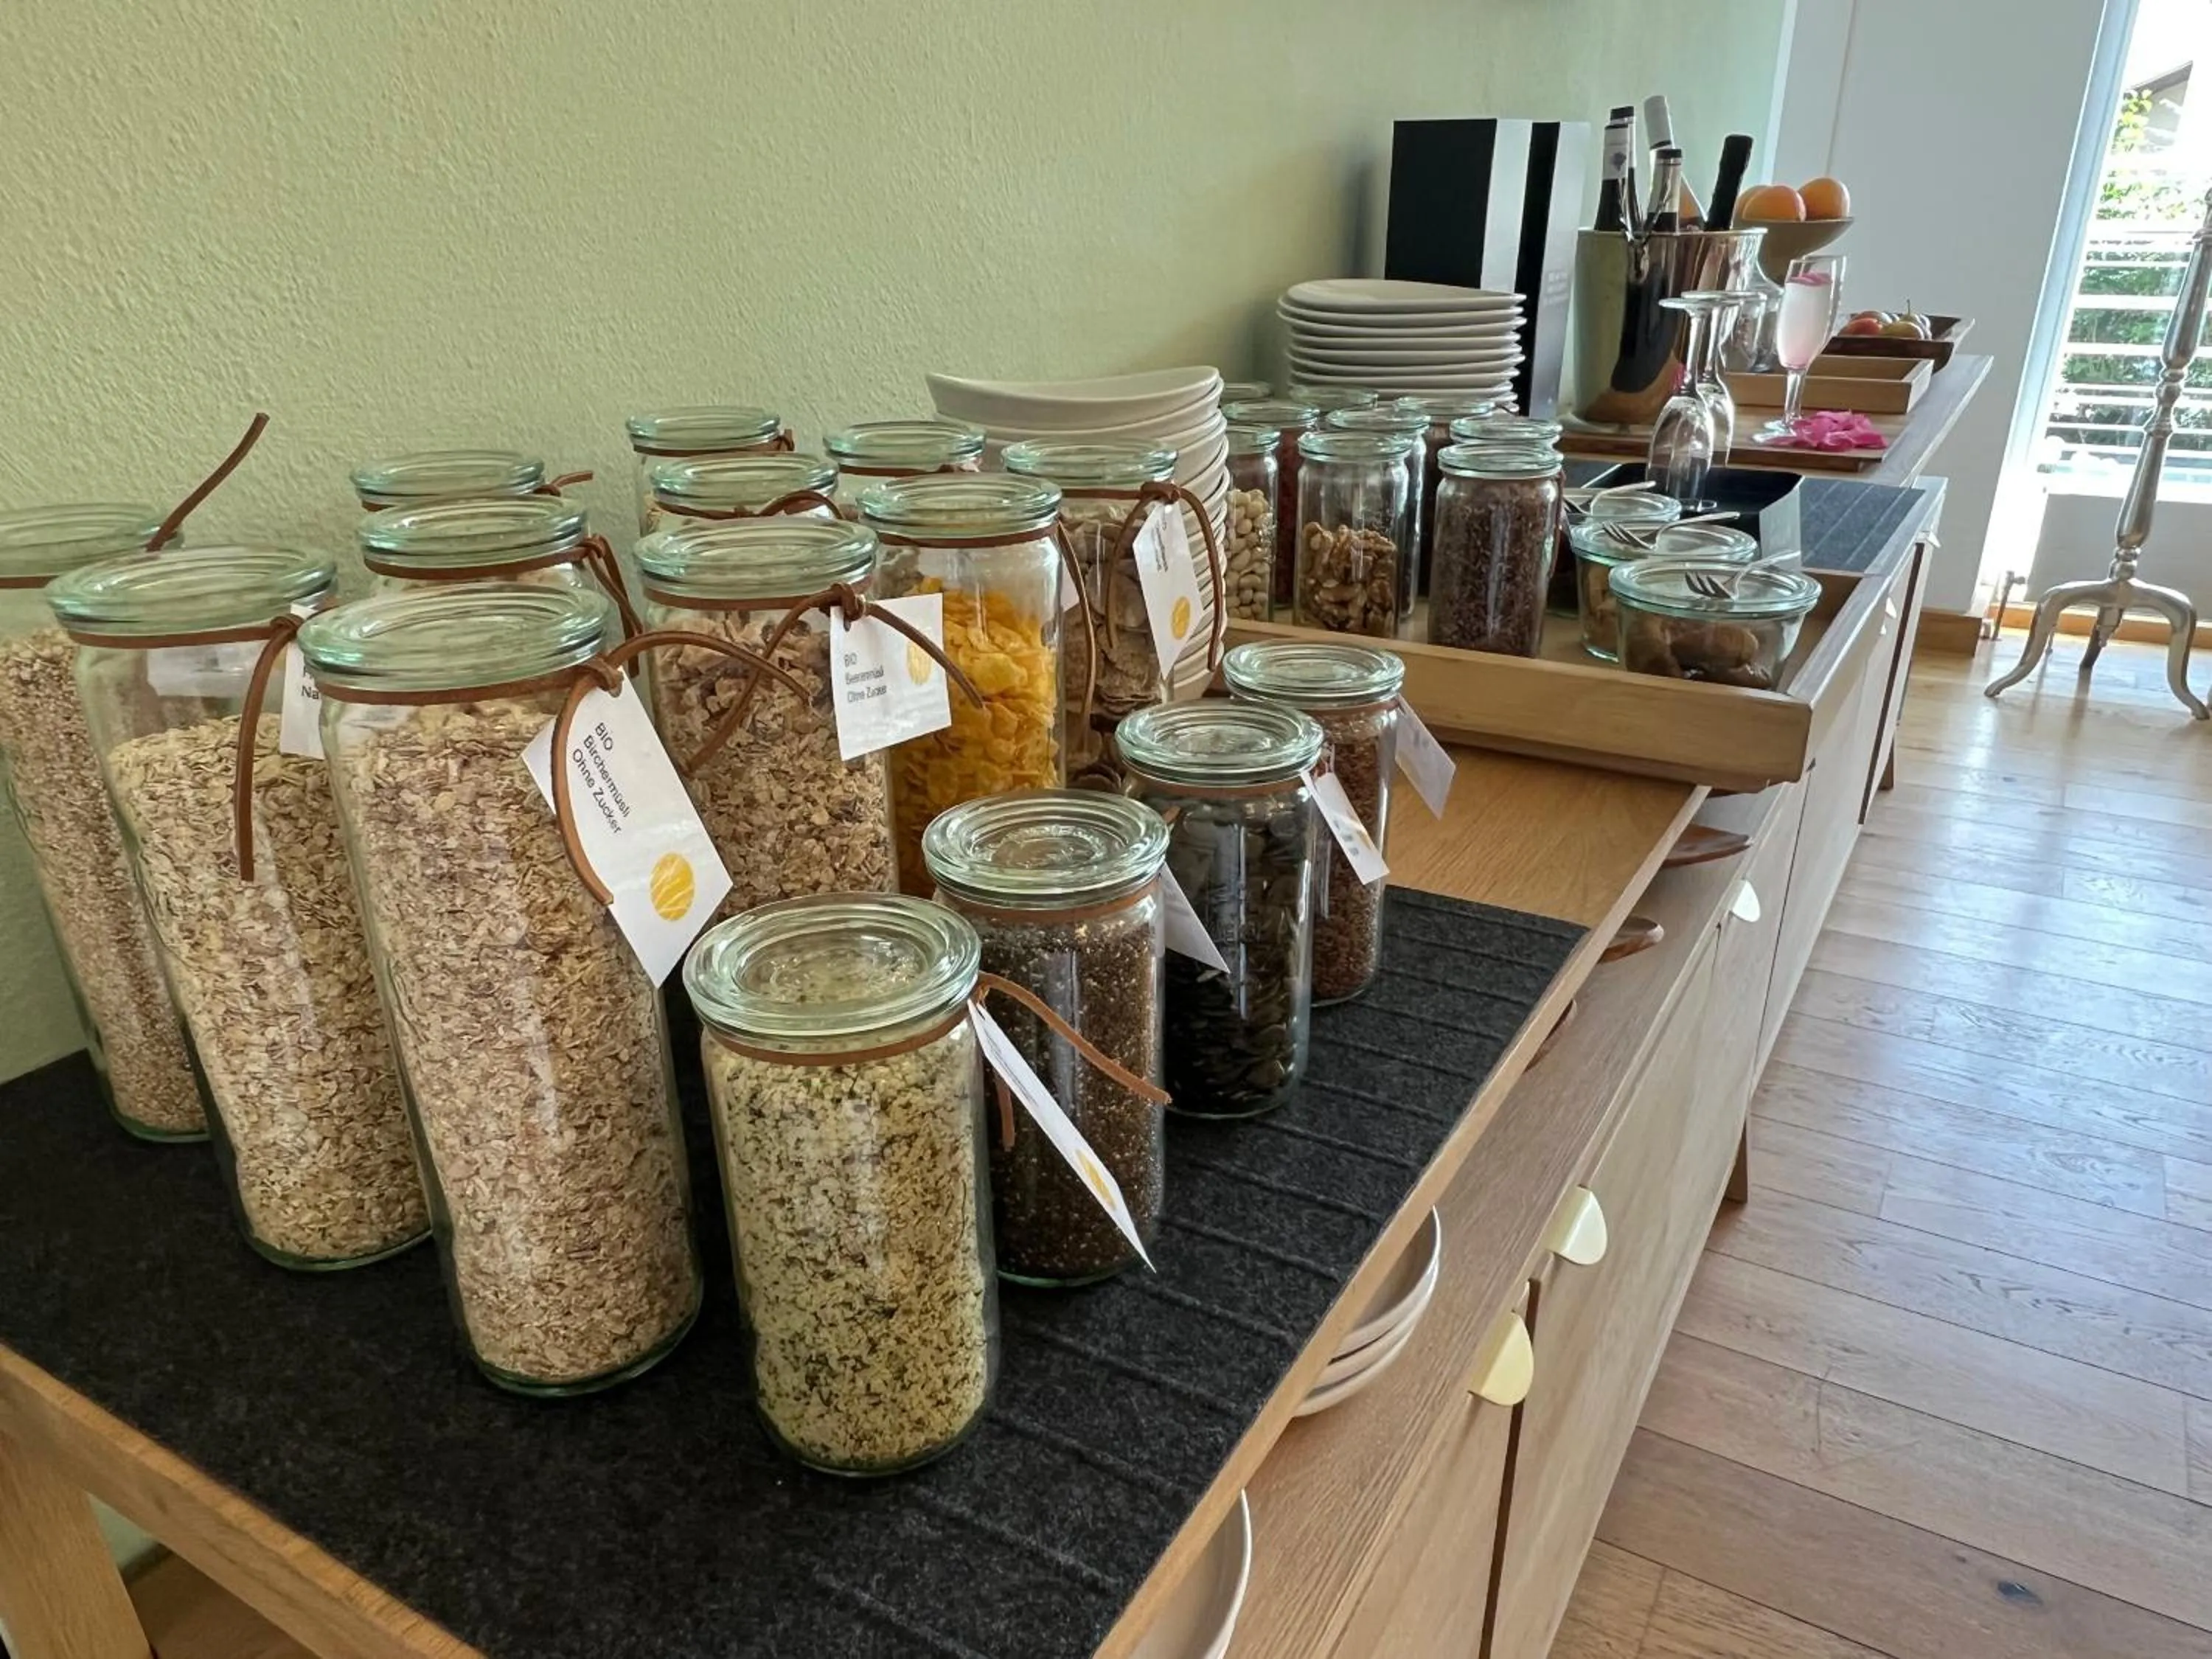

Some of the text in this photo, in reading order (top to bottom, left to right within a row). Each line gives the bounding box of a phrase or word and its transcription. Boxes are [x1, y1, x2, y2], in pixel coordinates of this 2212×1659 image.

[583, 735, 630, 818] Birchermüsli
[595, 722, 613, 751] BIO
[573, 748, 622, 833] Ohne Zucker
